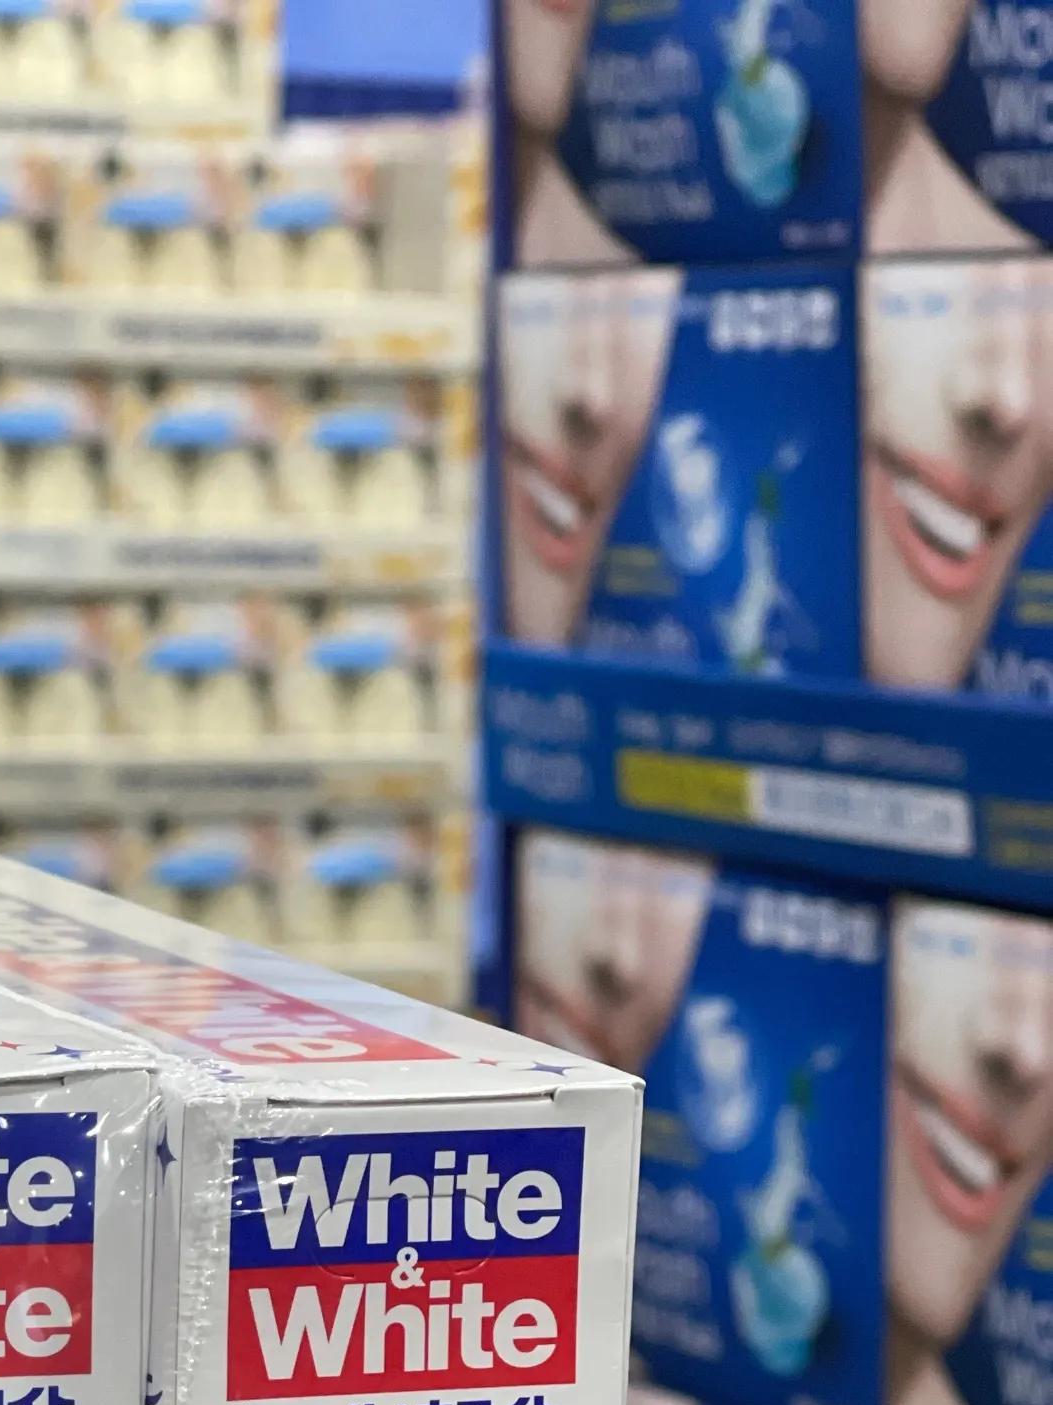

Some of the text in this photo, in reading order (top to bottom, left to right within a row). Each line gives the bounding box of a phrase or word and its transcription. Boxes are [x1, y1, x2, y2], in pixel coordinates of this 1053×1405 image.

[252, 1151, 563, 1250] White
[390, 1246, 426, 1289] &
[248, 1280, 558, 1381] White
